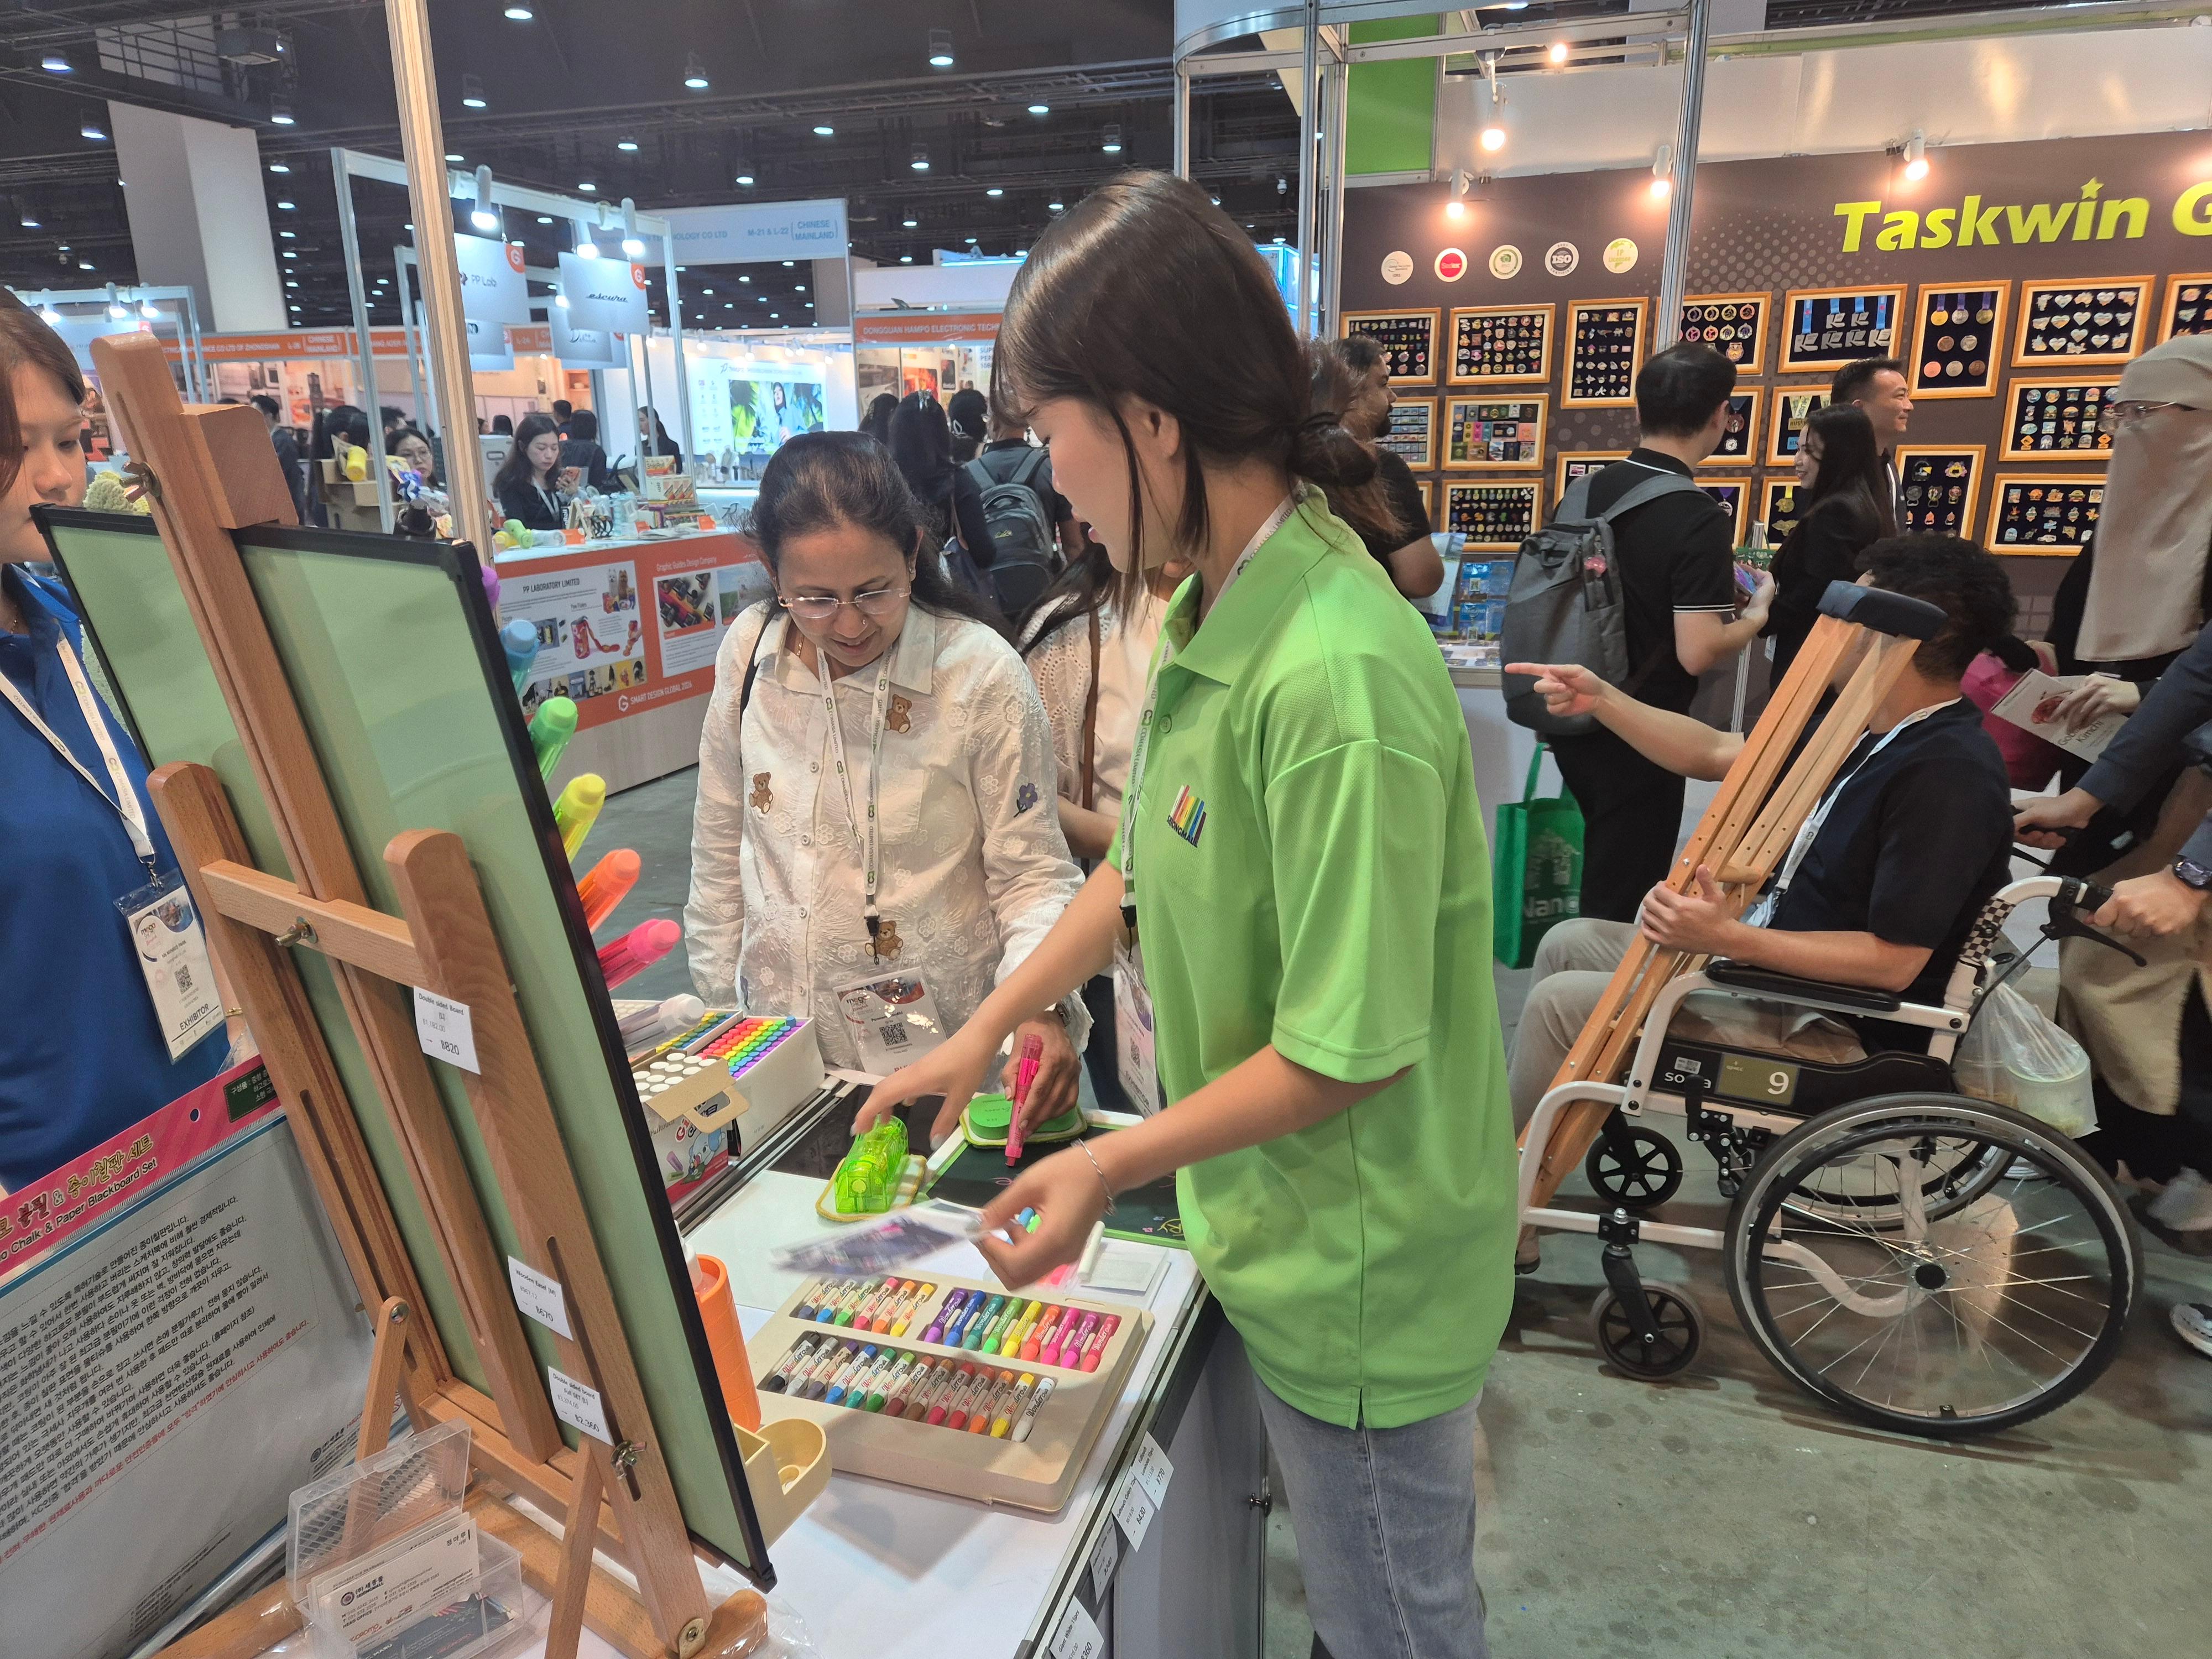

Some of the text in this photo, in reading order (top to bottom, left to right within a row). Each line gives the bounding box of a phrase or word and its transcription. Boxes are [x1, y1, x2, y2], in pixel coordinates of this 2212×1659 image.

[797, 220, 831, 229] CHINESE
[1834, 177, 2151, 253] Taskwin
[795, 231, 834, 241] MAINLAND
[1551, 254, 1572, 264] ISO
[523, 577, 580, 595] PP LABORATORY LIMITED
[178, 1004, 211, 1029] EXHIBITOR
[419, 993, 434, 1004] Double
[450, 1005, 464, 1015] Board
[1767, 1071, 1790, 1095] 9
[18, 1133, 153, 1230] 분필 & 종이칠판 세트
[11, 1228, 41, 1254] Chalk
[44, 1220, 53, 1234] &
[56, 1203, 85, 1227] Paper
[87, 1170, 139, 1207] Blackboard
[142, 1157, 156, 1174] Set
[139, 1214, 189, 1250] 종이칠판입니다.
[169, 1230, 183, 1245] 비해
[199, 1195, 238, 1224] 경제적입니다.
[219, 1213, 246, 1237] 좋습니다.
[161, 1235, 195, 1261] 지워집니다.
[102, 1381, 133, 1409] 있습니다.
[342, 1609, 373, 1629] HEAD OFFICE
[1057, 1637, 1067, 1652] Giant
[1063, 1623, 1073, 1639] White
